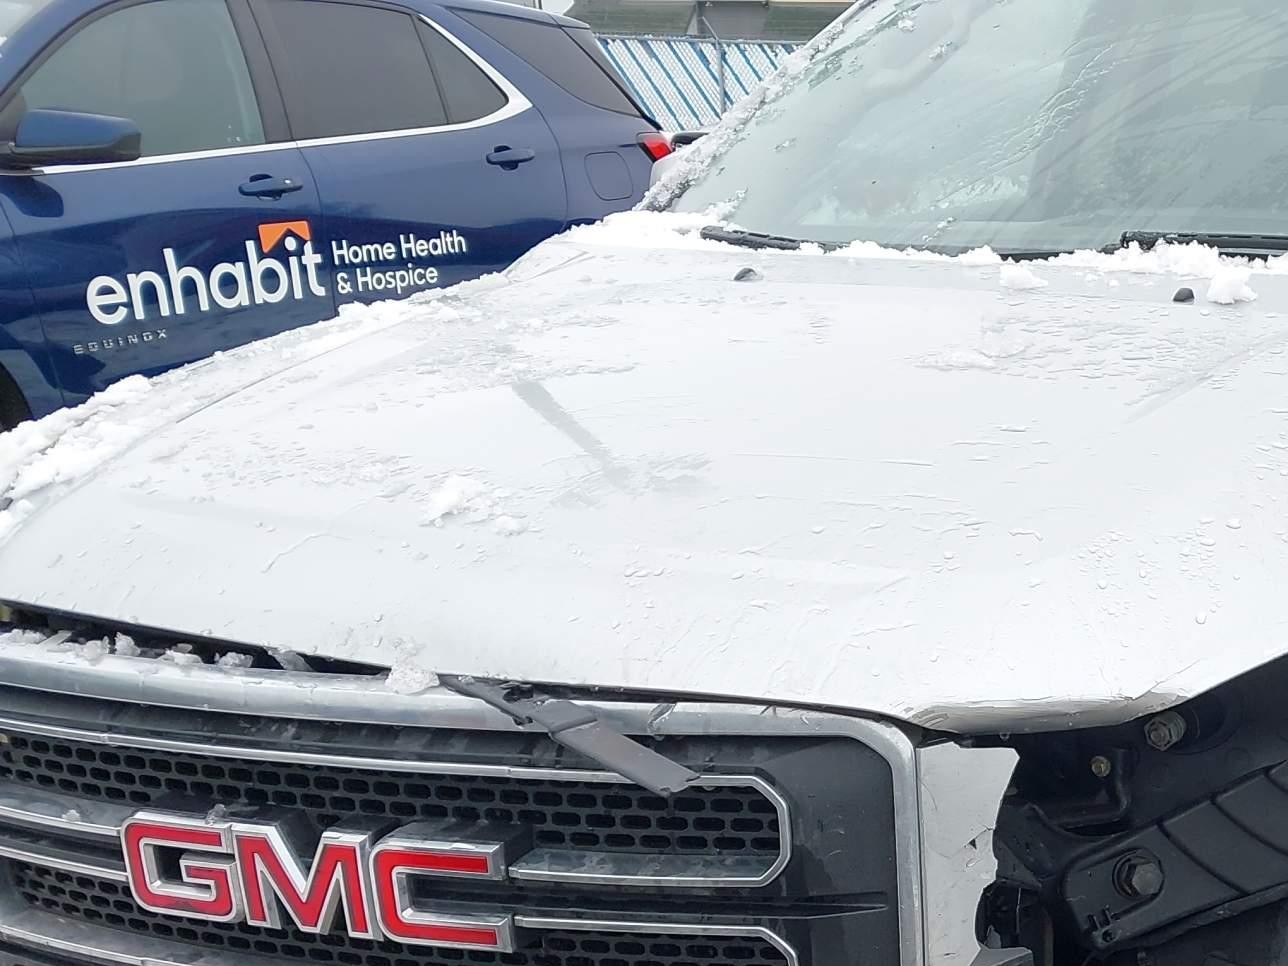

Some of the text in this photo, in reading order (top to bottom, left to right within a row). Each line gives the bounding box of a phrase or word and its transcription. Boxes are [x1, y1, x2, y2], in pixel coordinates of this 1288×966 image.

[332, 229, 467, 265] Home Health
[86, 236, 326, 325] enhabit
[336, 262, 438, 295] & Hospice
[73, 328, 167, 355] EQUINOX
[121, 809, 515, 953] GMC
